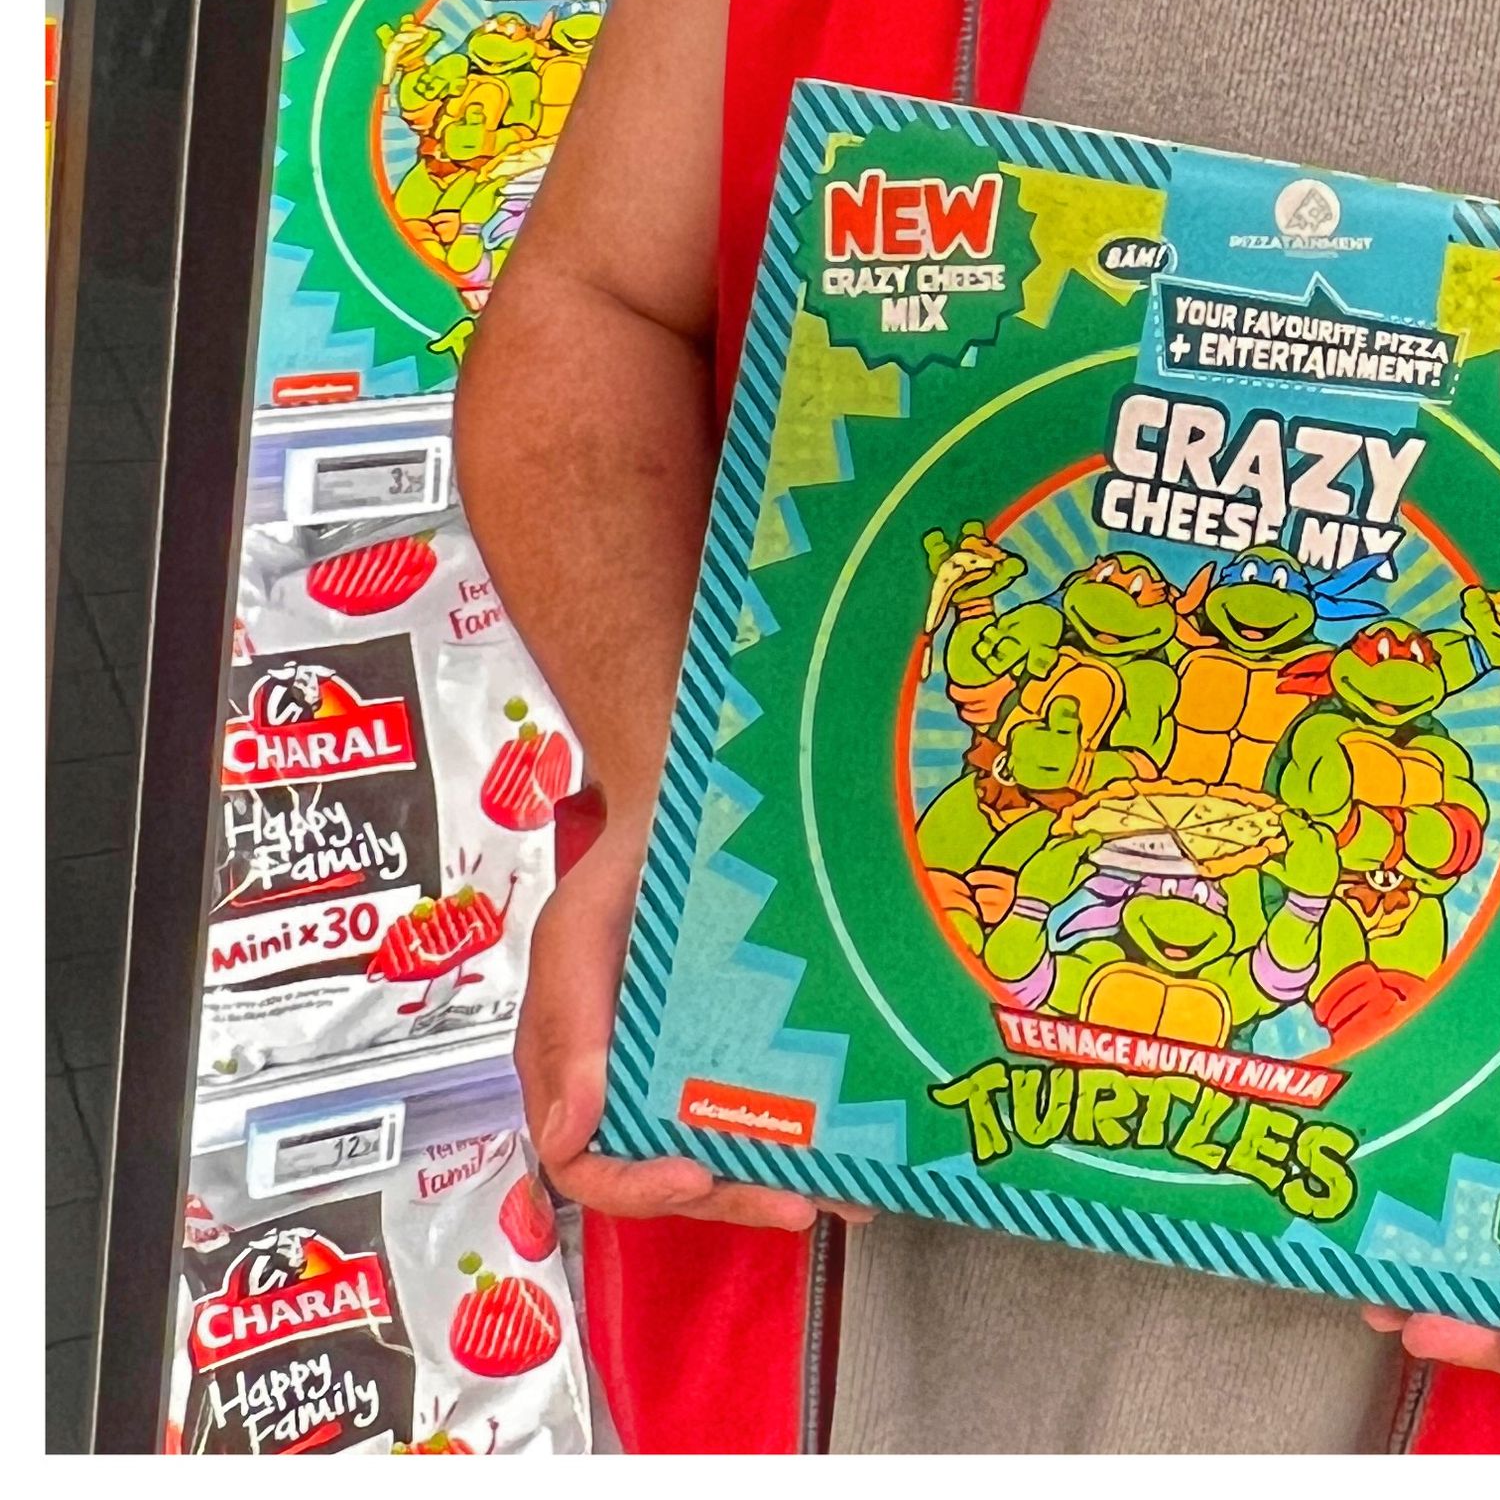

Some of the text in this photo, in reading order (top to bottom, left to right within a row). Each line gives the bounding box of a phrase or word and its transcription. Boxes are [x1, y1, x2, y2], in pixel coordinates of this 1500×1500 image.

[827, 172, 1000, 259] NEW
[823, 264, 1006, 298] CRAZY CHEESE
[882, 293, 949, 333] MIX
[1169, 331, 1444, 387] + ENTERTAINMENT!
[1175, 296, 1448, 363] YOUR FAVOURITE PIZZA
[1112, 393, 1427, 525] CRAZY
[1100, 478, 1404, 581] CHEESE MIX
[224, 719, 402, 773] CHARAL
[223, 799, 354, 852] Happy
[250, 822, 408, 891] Family
[211, 921, 293, 973] Mini
[1003, 1012, 1330, 1101] TEENAGE MUTANT NINJA
[930, 1061, 1358, 1221] TURTLES
[197, 1272, 381, 1348] CHARAL
[209, 1353, 332, 1428] Happy
[242, 1370, 379, 1454] Family
